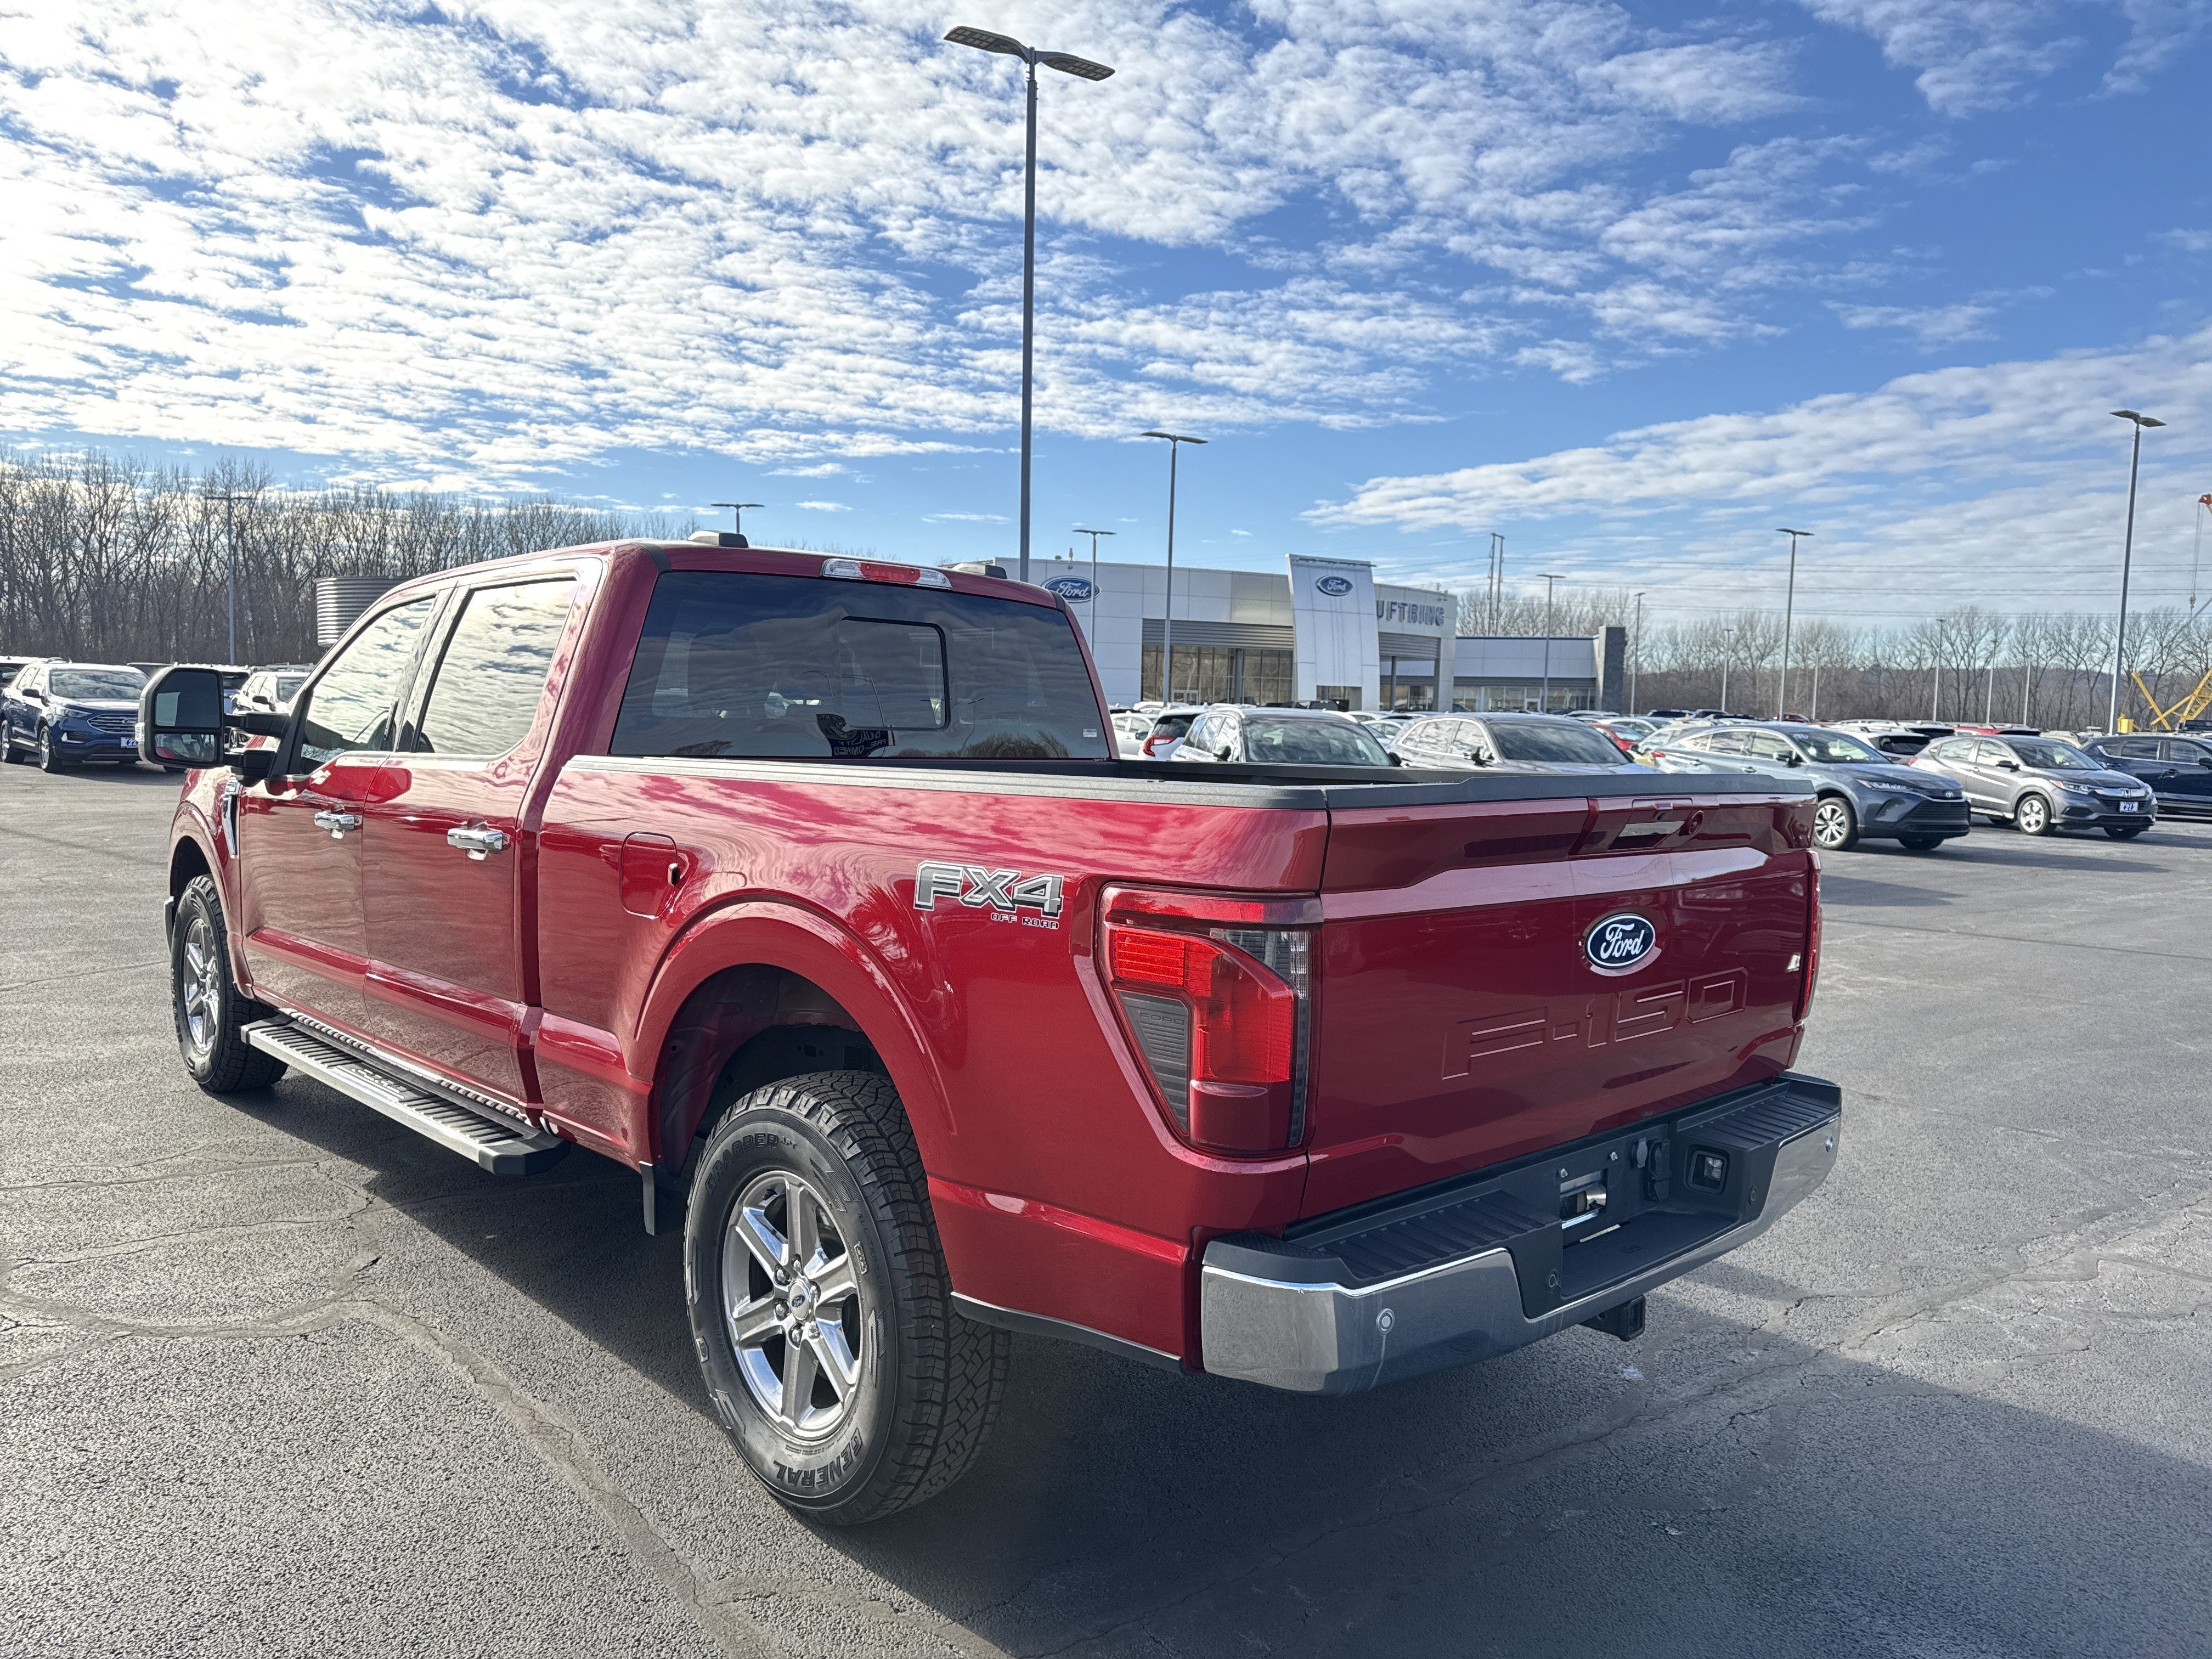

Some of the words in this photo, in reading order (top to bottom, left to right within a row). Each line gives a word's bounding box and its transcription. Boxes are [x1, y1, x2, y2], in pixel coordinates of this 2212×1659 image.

[1056, 582, 1089, 597] Ford
[1327, 579, 1347, 591] Ford
[1376, 600, 1444, 627] UFTRING
[913, 860, 1064, 919] FX4
[991, 912, 1018, 923] OFF
[1022, 917, 1059, 930] ROAD
[1600, 923, 1645, 959] Ford
[1140, 1012, 1185, 1025] FORD
[1442, 966, 1749, 1080] F-150
[704, 1132, 778, 1196] GRABBER
[793, 1296, 803, 1307] Ford
[773, 1427, 863, 1488] GENERAL
